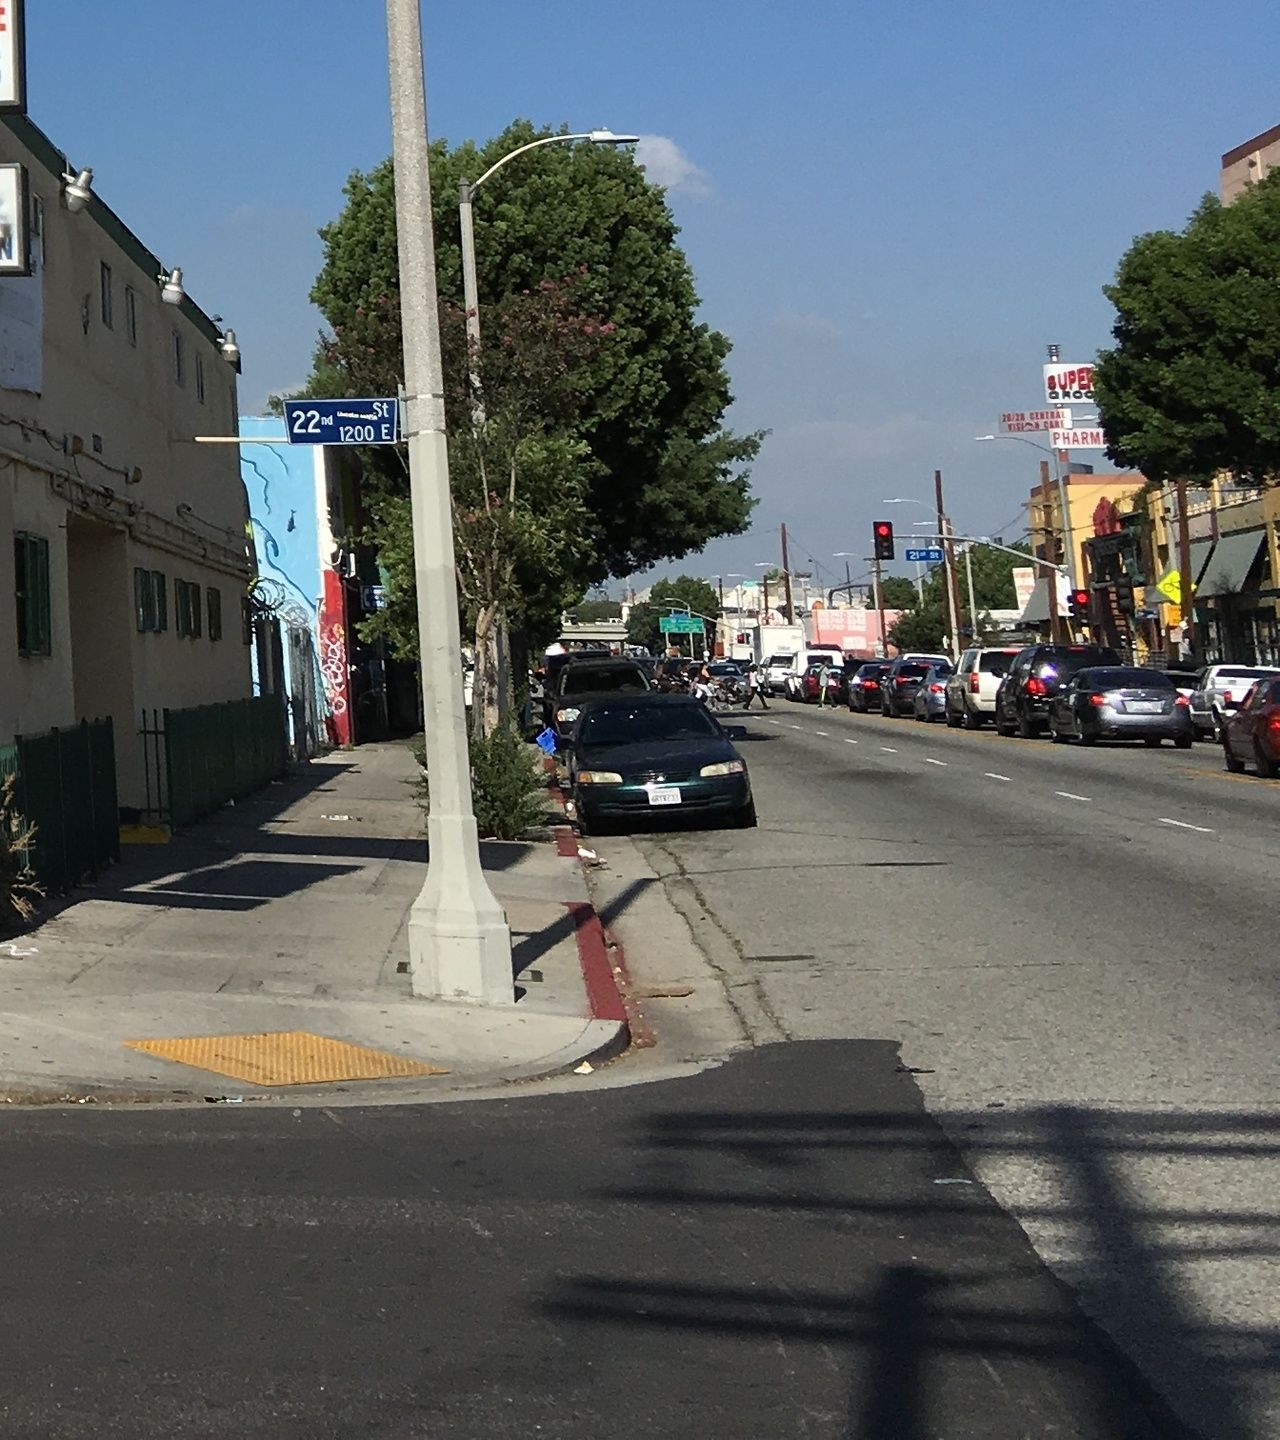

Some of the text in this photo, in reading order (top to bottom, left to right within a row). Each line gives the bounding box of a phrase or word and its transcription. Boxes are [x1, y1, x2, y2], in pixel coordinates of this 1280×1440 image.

[291, 410, 333, 434] 22nd
[372, 402, 389, 418] St
[339, 424, 391, 442] 1200 E
